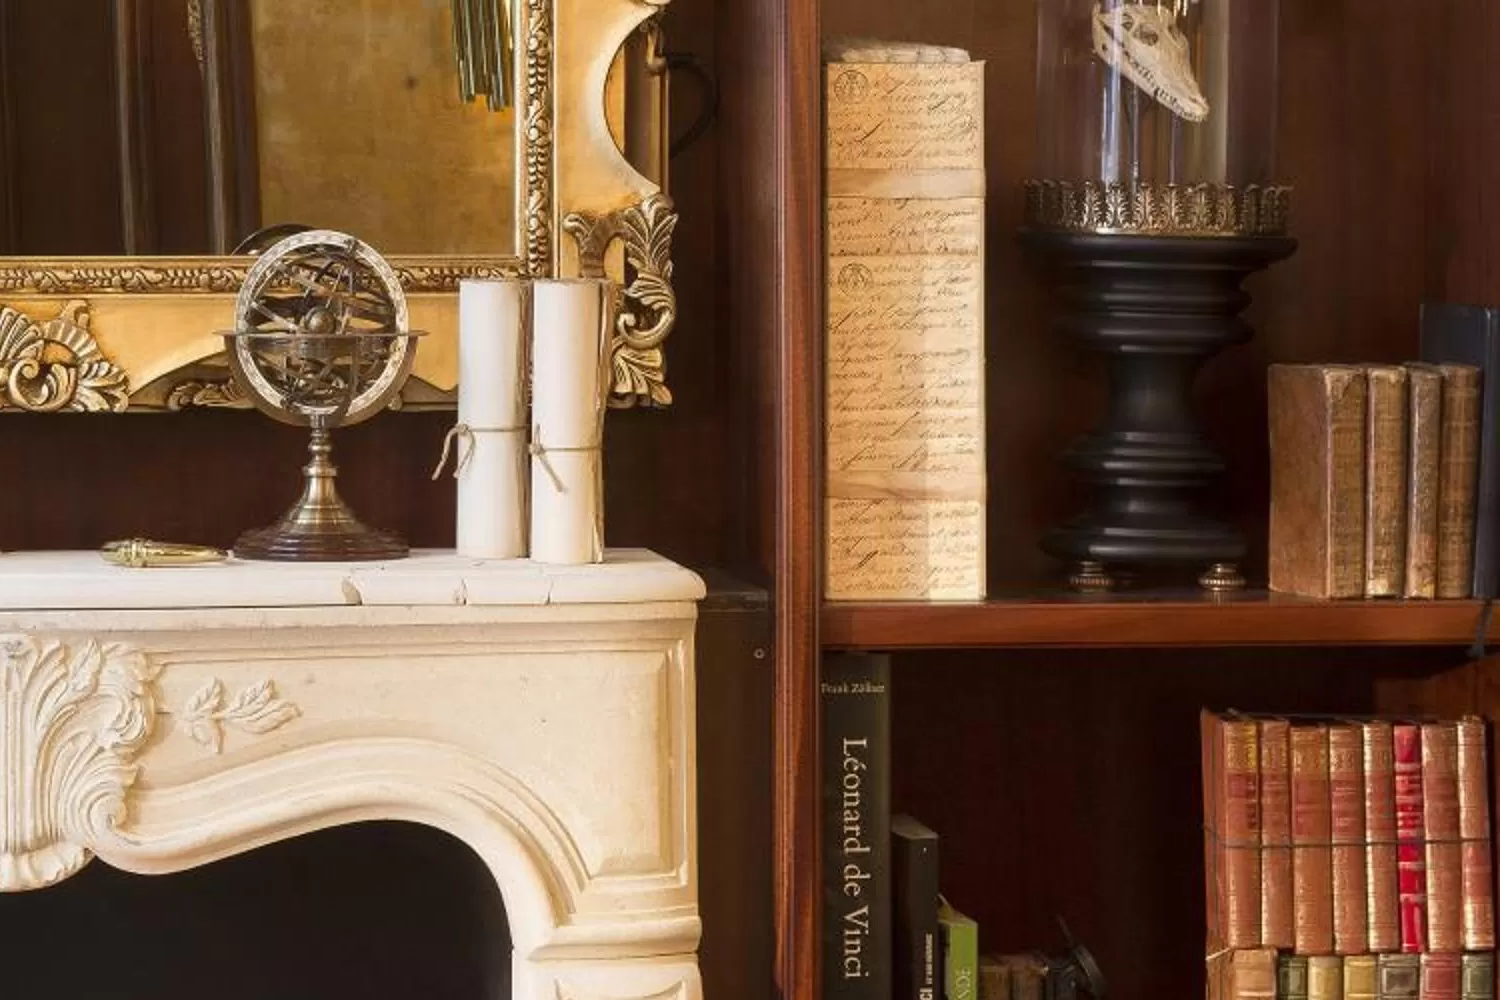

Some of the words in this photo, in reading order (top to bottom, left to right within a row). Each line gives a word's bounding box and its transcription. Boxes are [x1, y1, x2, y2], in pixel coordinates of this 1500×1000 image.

[842, 737, 871, 855] Léonard
[843, 864, 871, 897] de
[843, 904, 870, 979] Vinci
